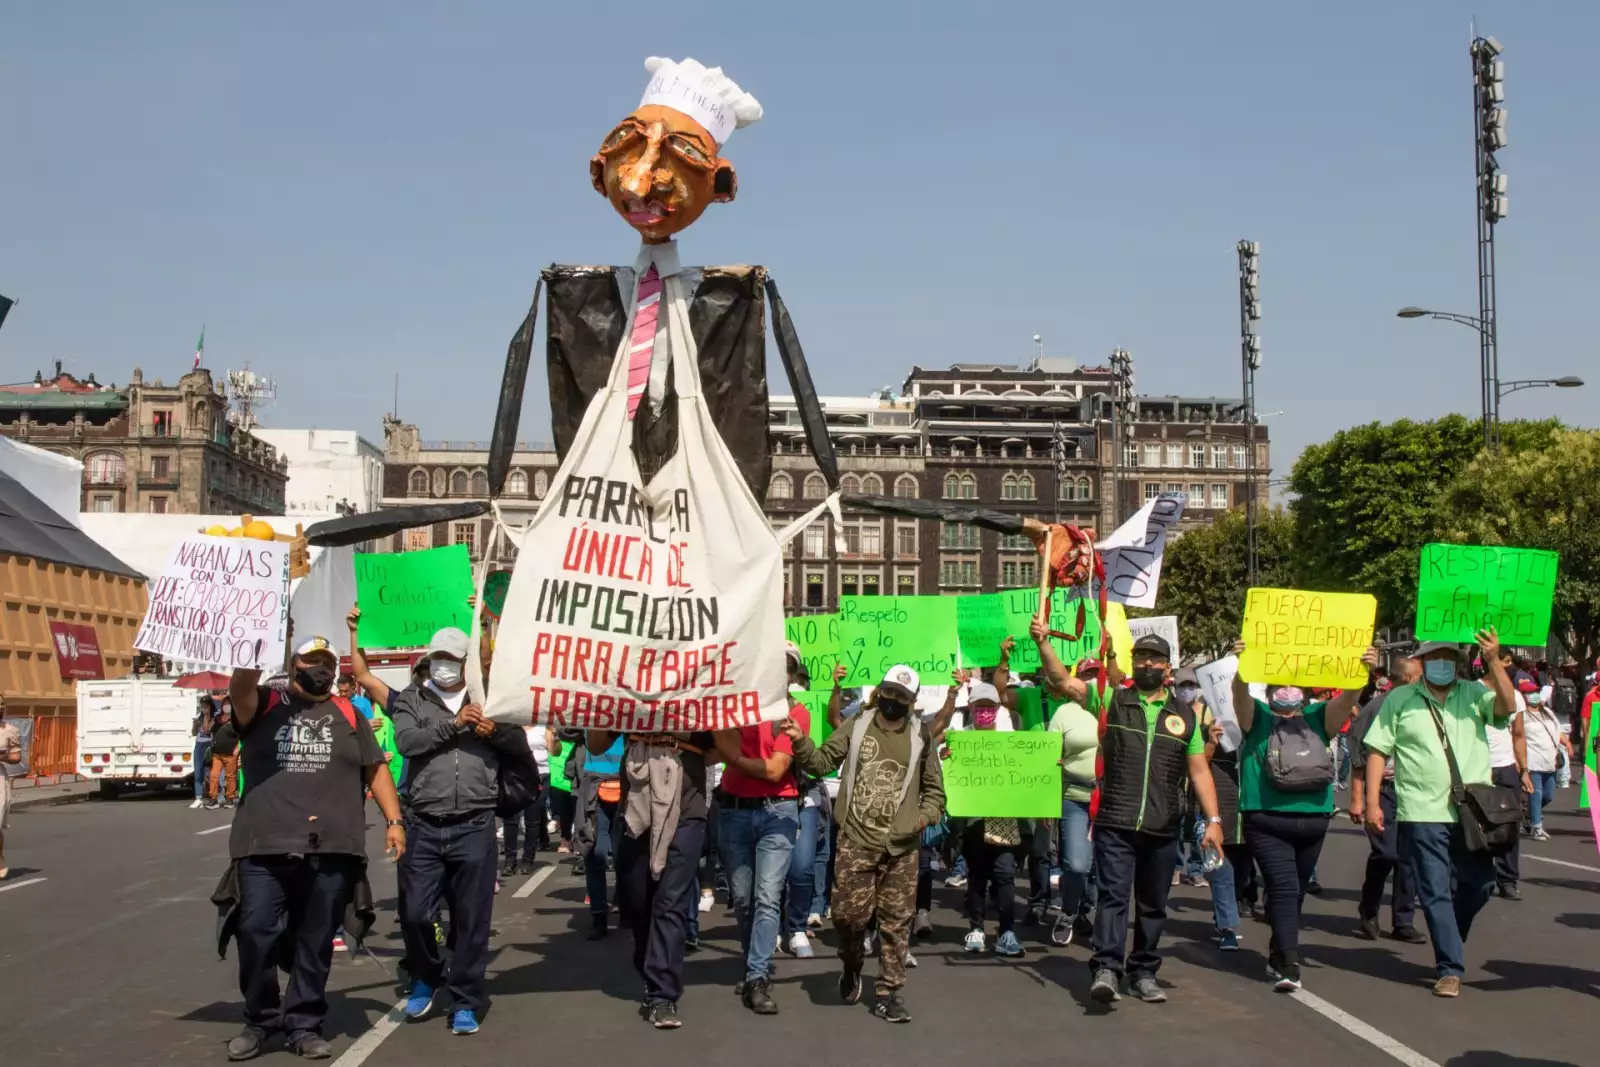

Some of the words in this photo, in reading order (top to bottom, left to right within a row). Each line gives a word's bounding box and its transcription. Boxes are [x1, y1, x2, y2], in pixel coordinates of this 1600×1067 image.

[559, 475, 644, 527] PARA
[174, 541, 273, 578] NARANJAS
[563, 521, 652, 585] ÚNICA
[667, 542, 691, 588] DE
[1428, 544, 1549, 586] RESPETO
[190, 569, 214, 583] CON
[222, 573, 236, 586] SU
[535, 578, 719, 642] IMPOSICIÓN
[840, 599, 908, 629] ¡Respeto
[1249, 591, 1323, 622] FUERA
[1453, 585, 1470, 611] A
[1485, 587, 1516, 612] LO
[148, 601, 226, 636] TRANSITORIO
[230, 616, 246, 639] 6
[788, 620, 817, 645] NO
[1255, 621, 1373, 649] ABOGADOS
[1423, 606, 1535, 637] GANADO
[178, 631, 222, 663] MANDO
[853, 637, 866, 648] a
[878, 630, 894, 648] lo
[531, 632, 614, 685] PARA
[616, 644, 657, 692] LA
[660, 641, 738, 692] BASE
[846, 650, 871, 683] Ya
[530, 685, 762, 732] TRABAJADORA
[277, 741, 332, 754] OUTFITTERS
[947, 770, 1004, 788] Salario
[1008, 770, 1053, 788] Digno
